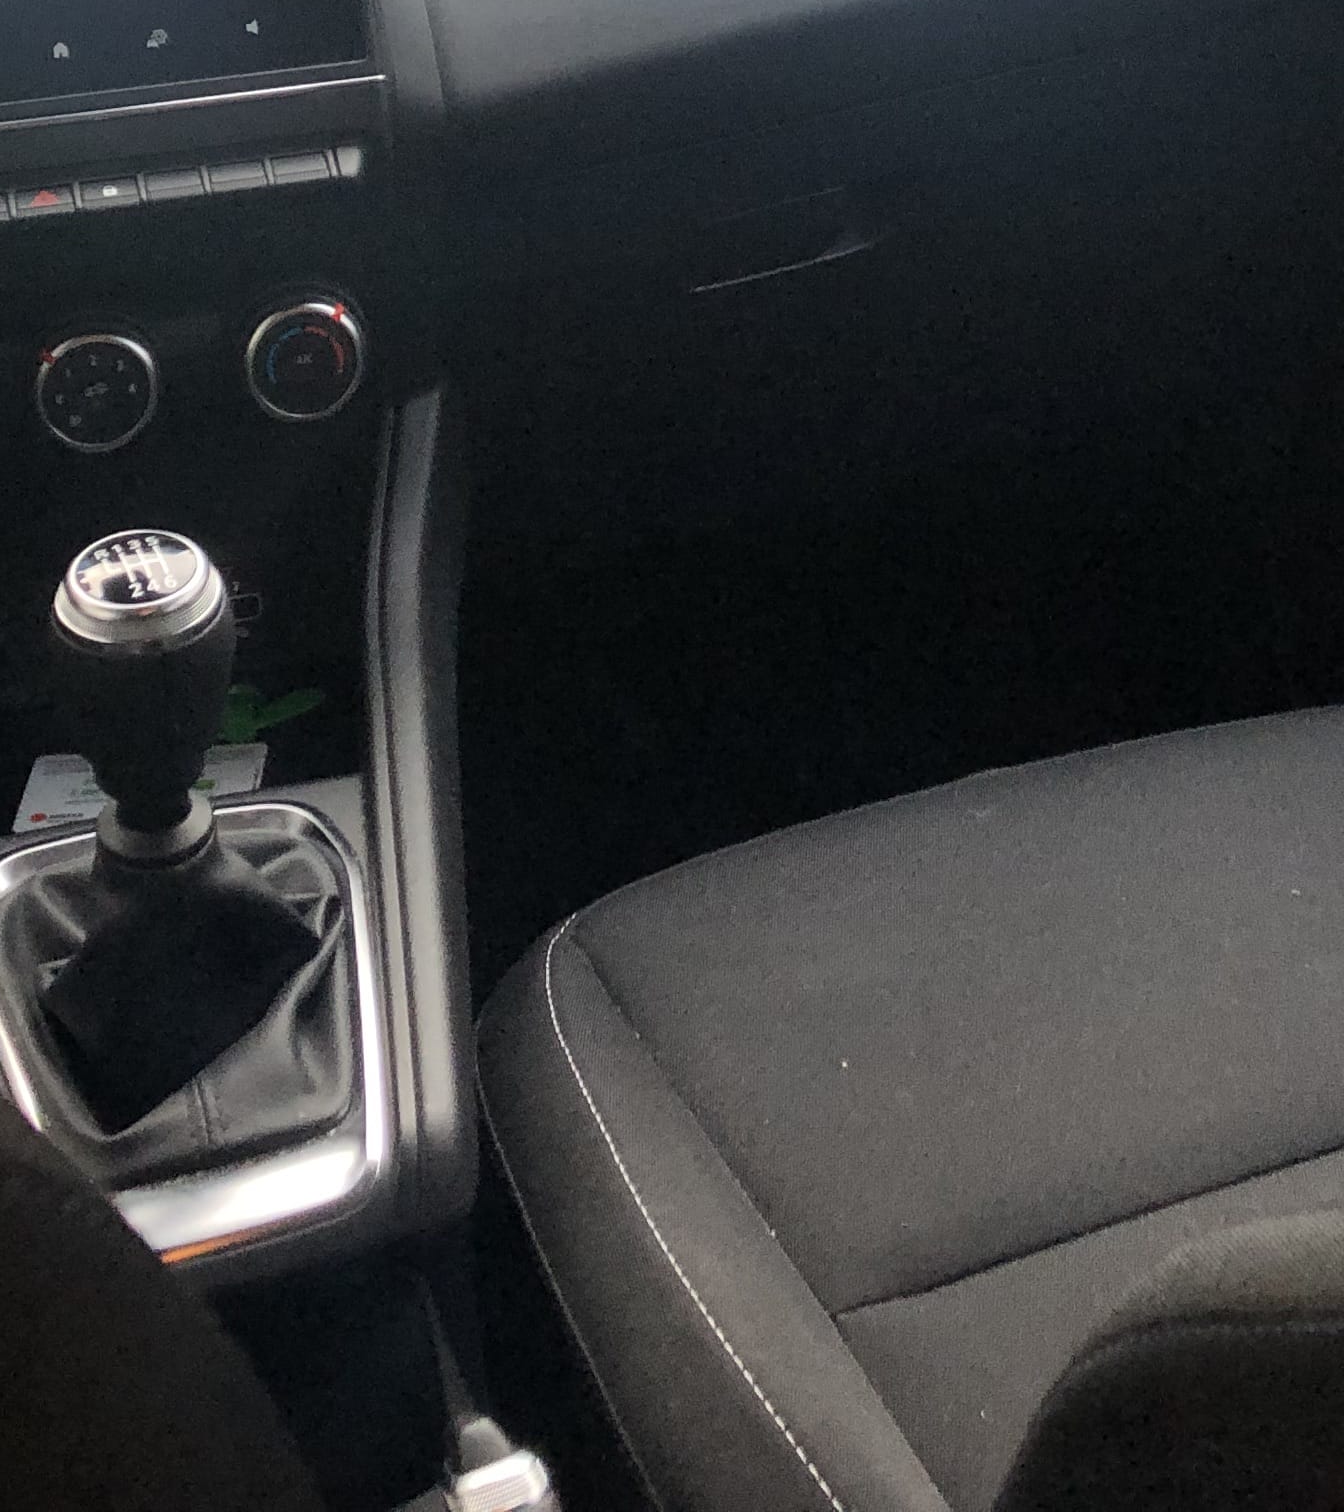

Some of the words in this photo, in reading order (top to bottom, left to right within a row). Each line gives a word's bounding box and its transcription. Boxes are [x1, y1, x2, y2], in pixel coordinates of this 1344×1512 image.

[128, 582, 145, 599] 2
[147, 578, 160, 592] 4
[164, 576, 177, 588] 6
